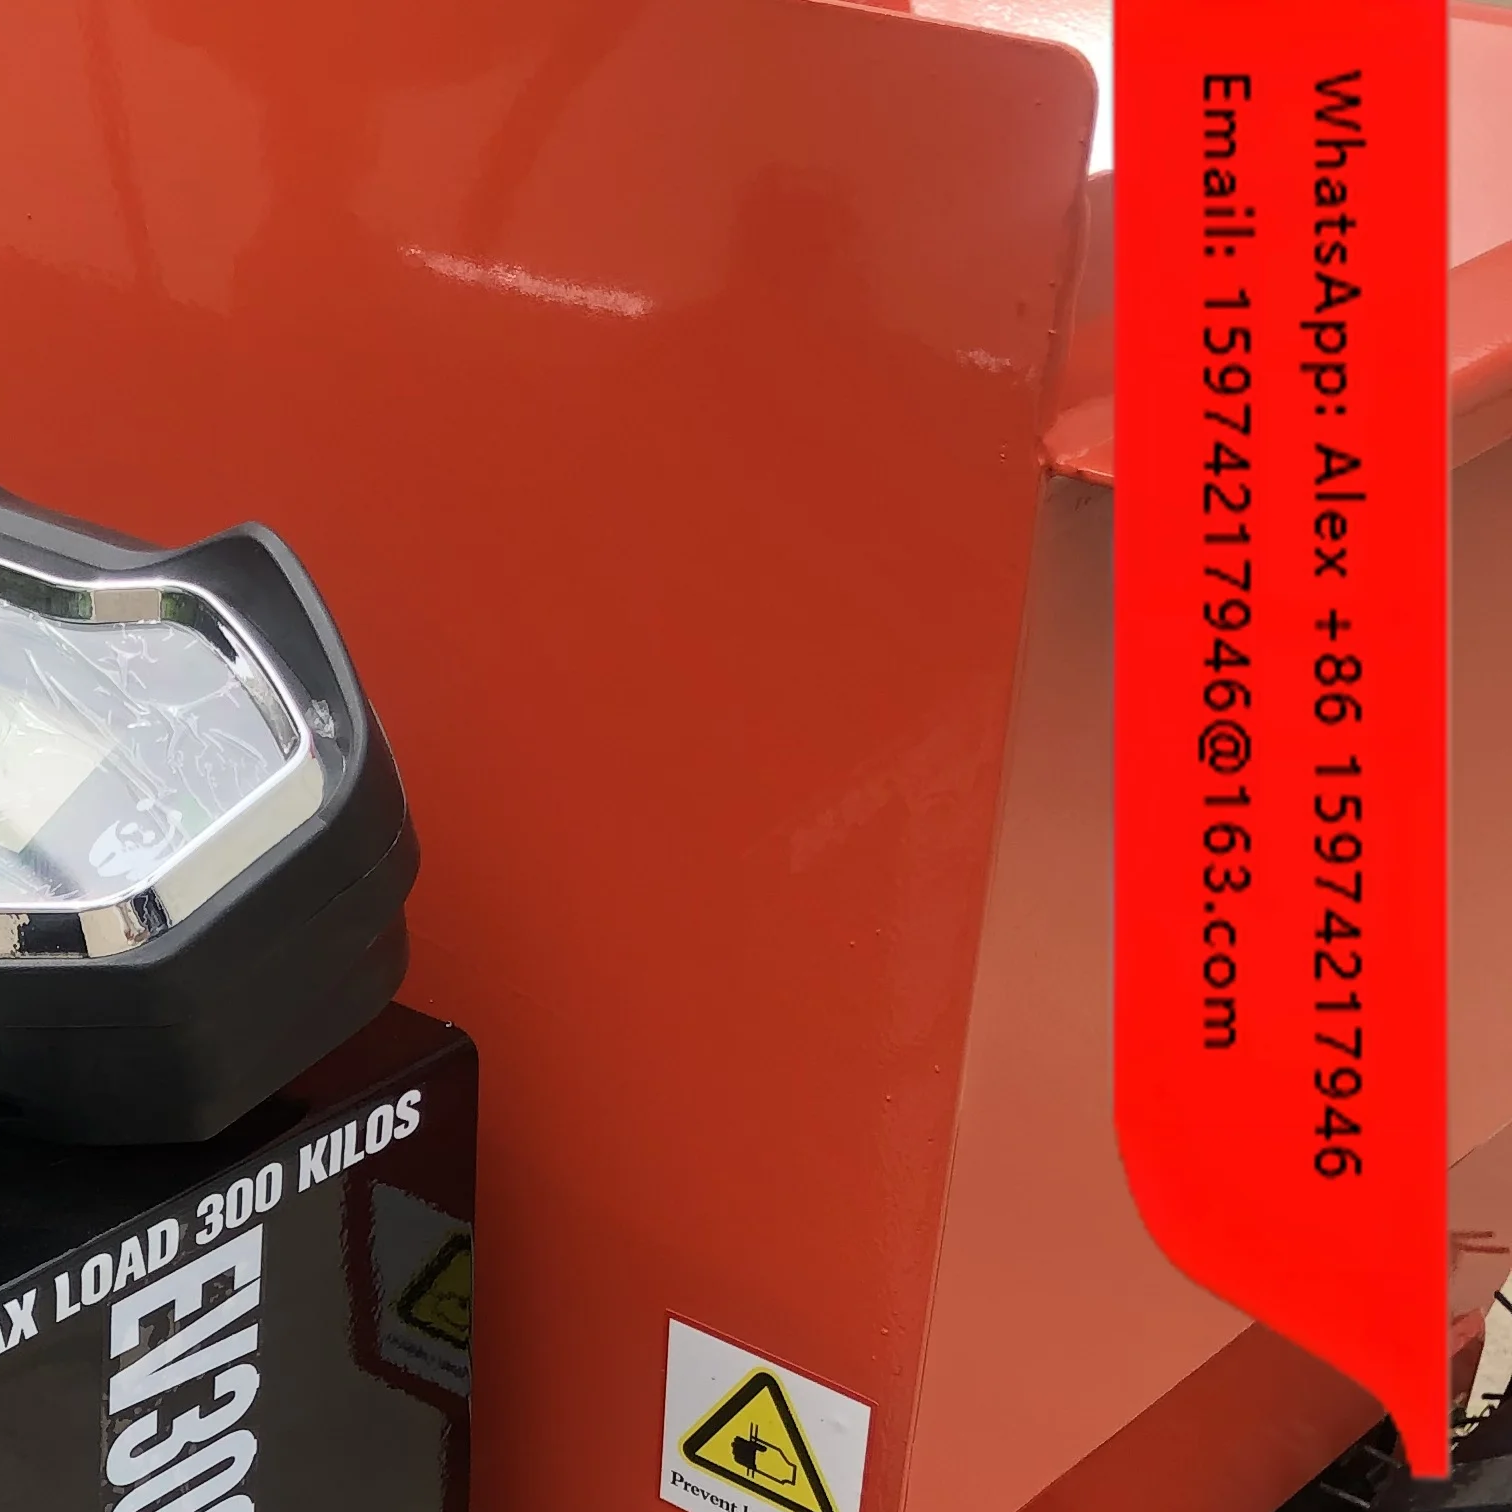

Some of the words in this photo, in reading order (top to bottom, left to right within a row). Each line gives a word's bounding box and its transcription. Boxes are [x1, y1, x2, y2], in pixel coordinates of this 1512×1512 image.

[53, 1217, 181, 1324] LOAD
[195, 1162, 284, 1246] 300
[298, 1089, 423, 1194] KILOS
